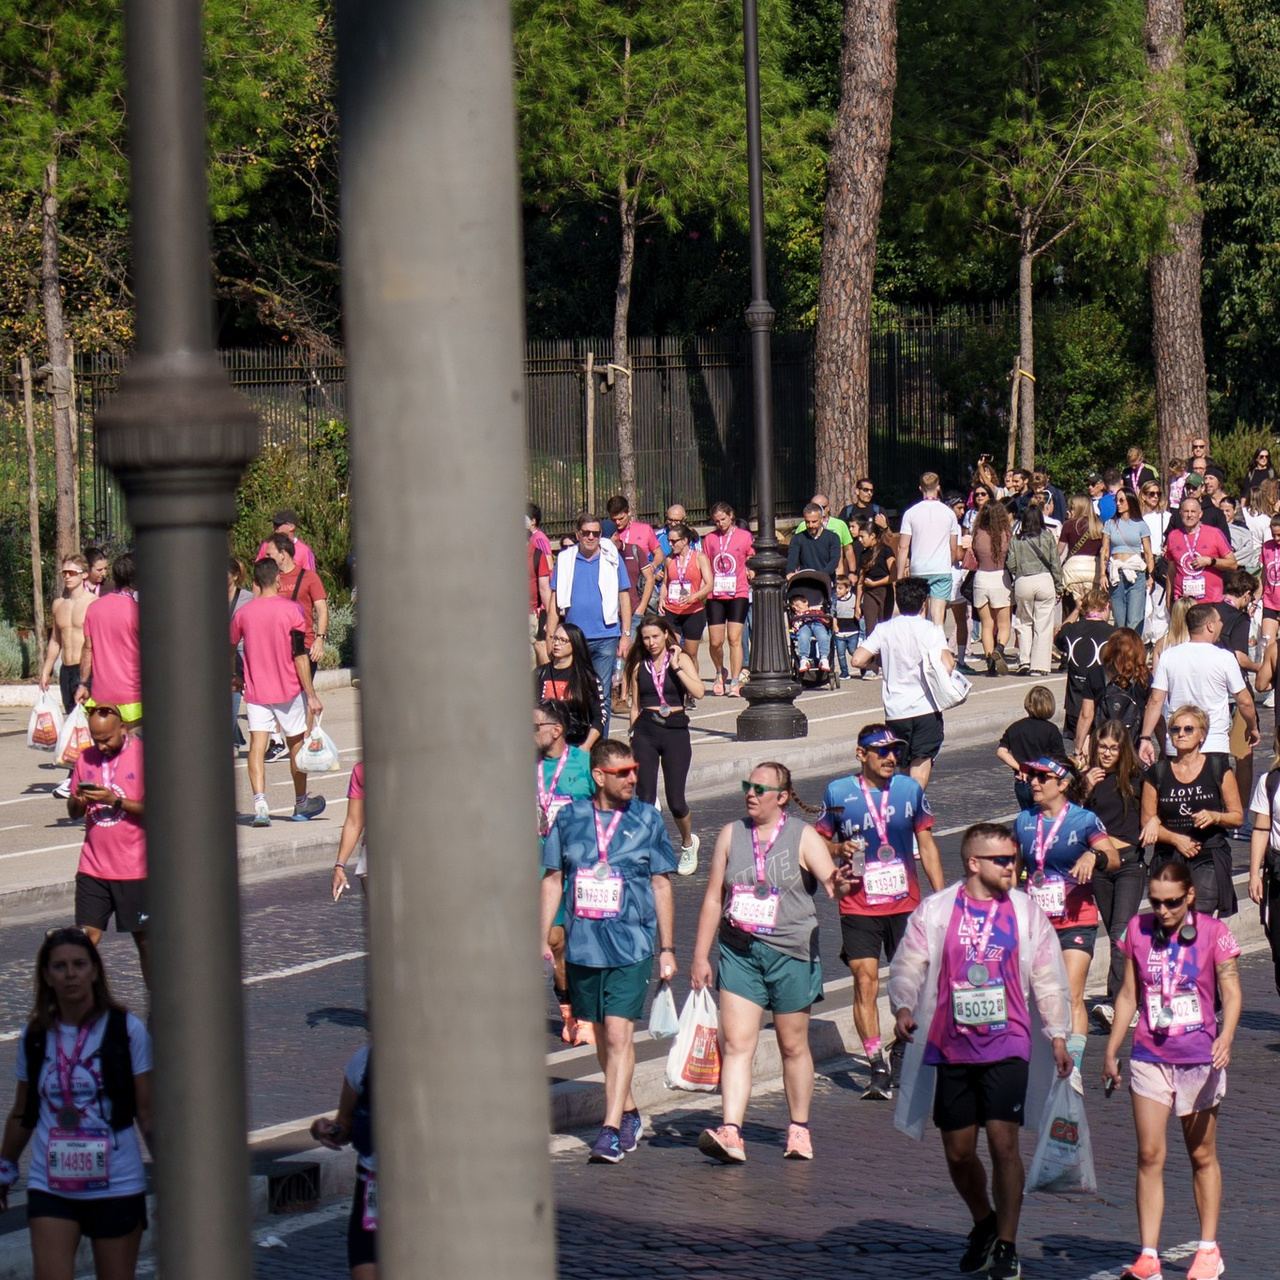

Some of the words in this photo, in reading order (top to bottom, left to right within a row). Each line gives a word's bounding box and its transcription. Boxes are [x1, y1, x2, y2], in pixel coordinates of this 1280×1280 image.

[1170, 785, 1203, 797] LOVE
[1179, 803, 1193, 816] &
[964, 1000, 996, 1018] 5032
[60, 1151, 94, 1172] 14836
